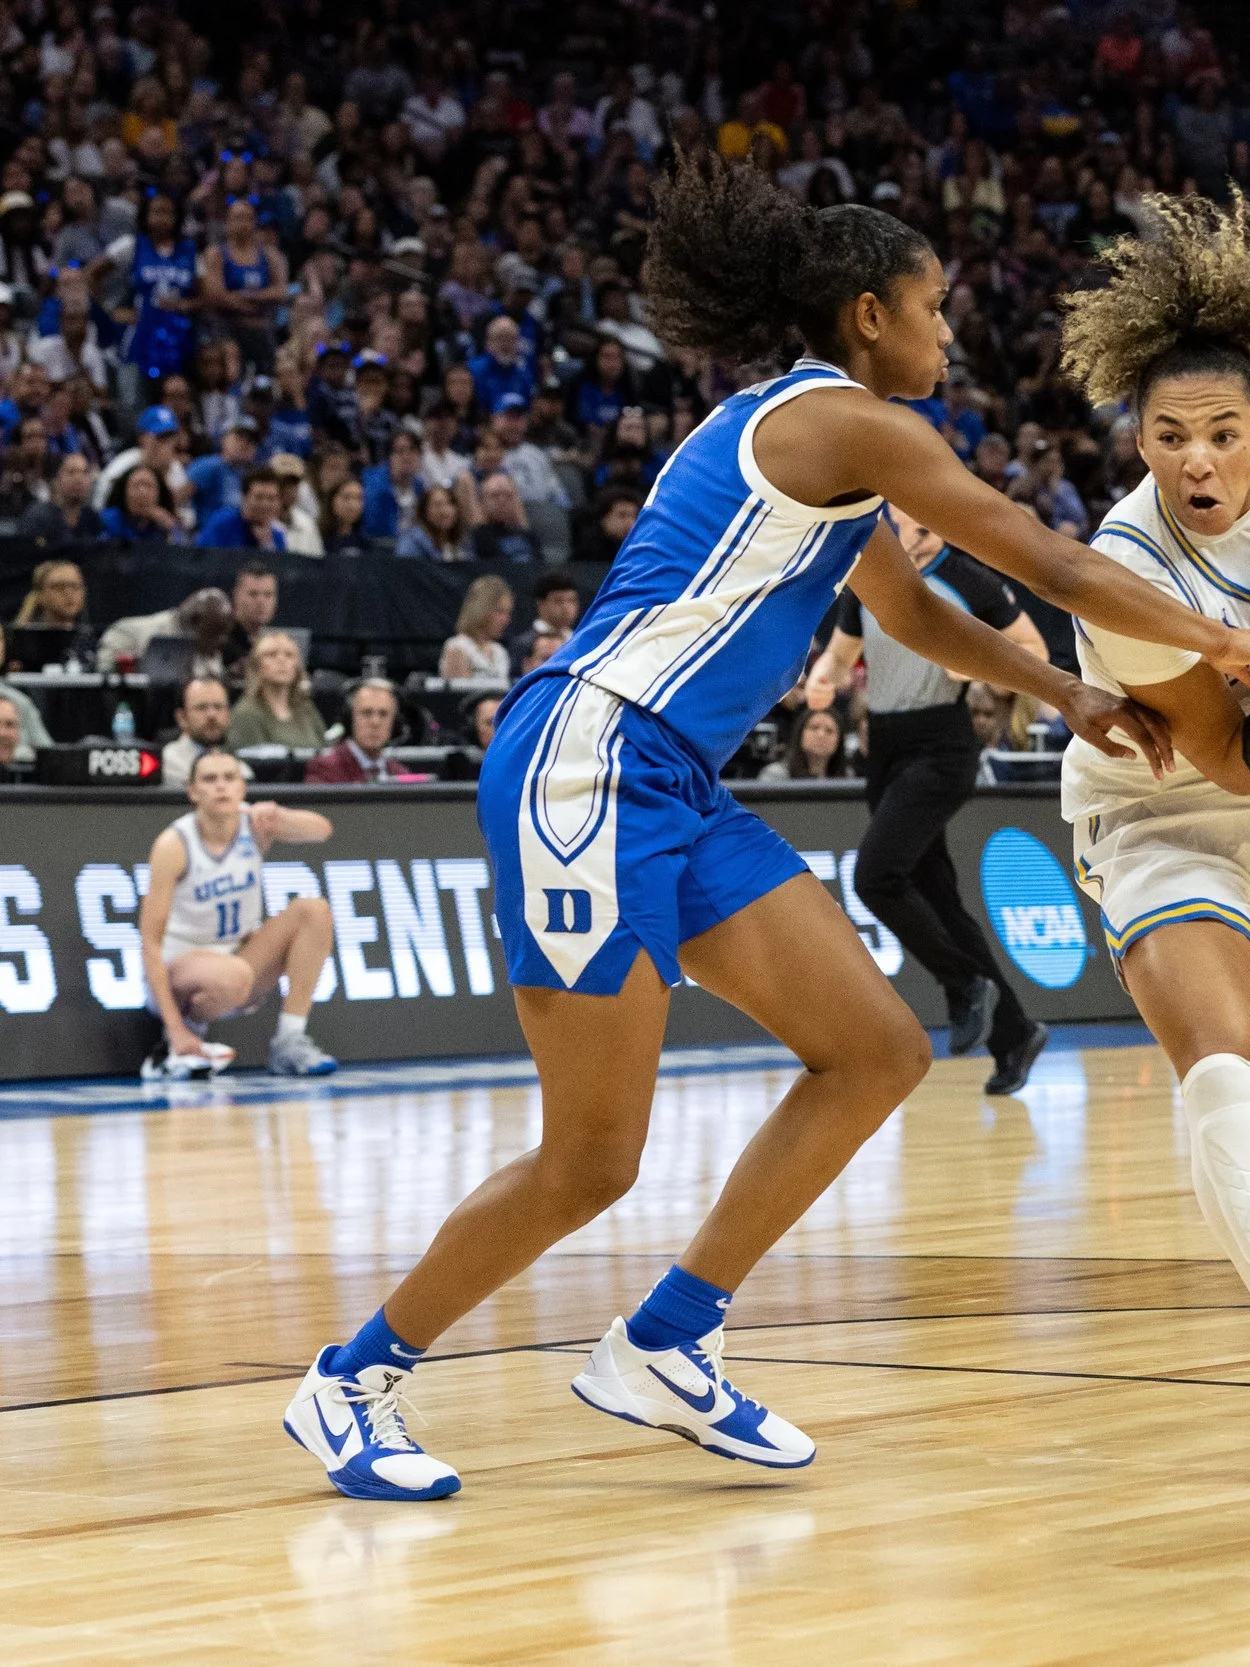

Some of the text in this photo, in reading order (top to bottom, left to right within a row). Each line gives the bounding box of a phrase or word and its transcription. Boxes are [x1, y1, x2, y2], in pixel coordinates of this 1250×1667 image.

[194, 869, 256, 902] UCLA
[217, 901, 240, 938] 11
[541, 888, 592, 934] D
[1001, 904, 1087, 948] NCAA
